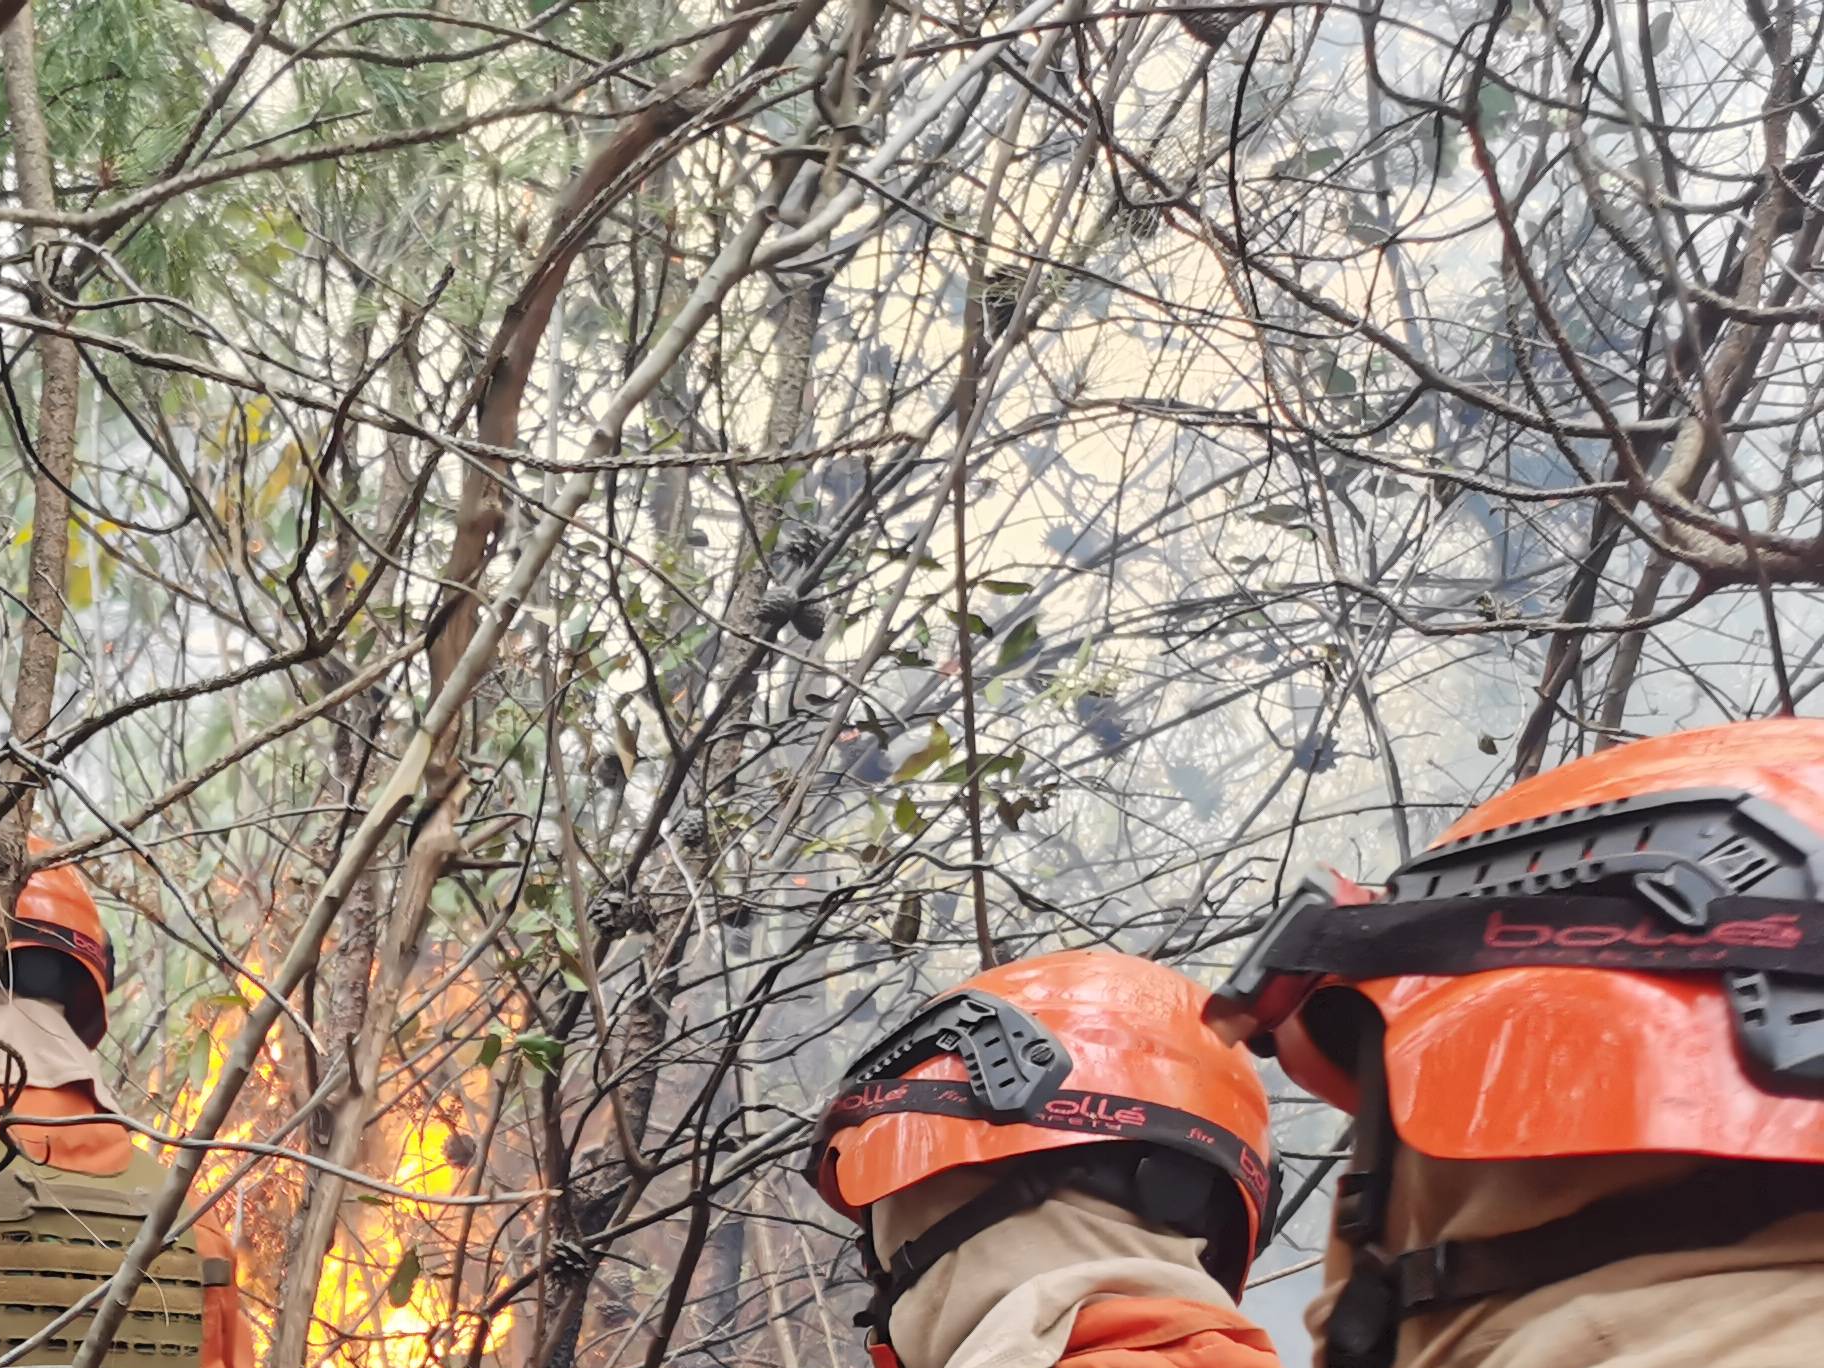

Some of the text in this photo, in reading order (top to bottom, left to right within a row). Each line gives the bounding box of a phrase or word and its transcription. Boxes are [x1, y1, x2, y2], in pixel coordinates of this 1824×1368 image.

[830, 1083, 910, 1111] ollé
[1044, 1096, 1147, 1126] ollé
[1185, 1127, 1216, 1145] fire
